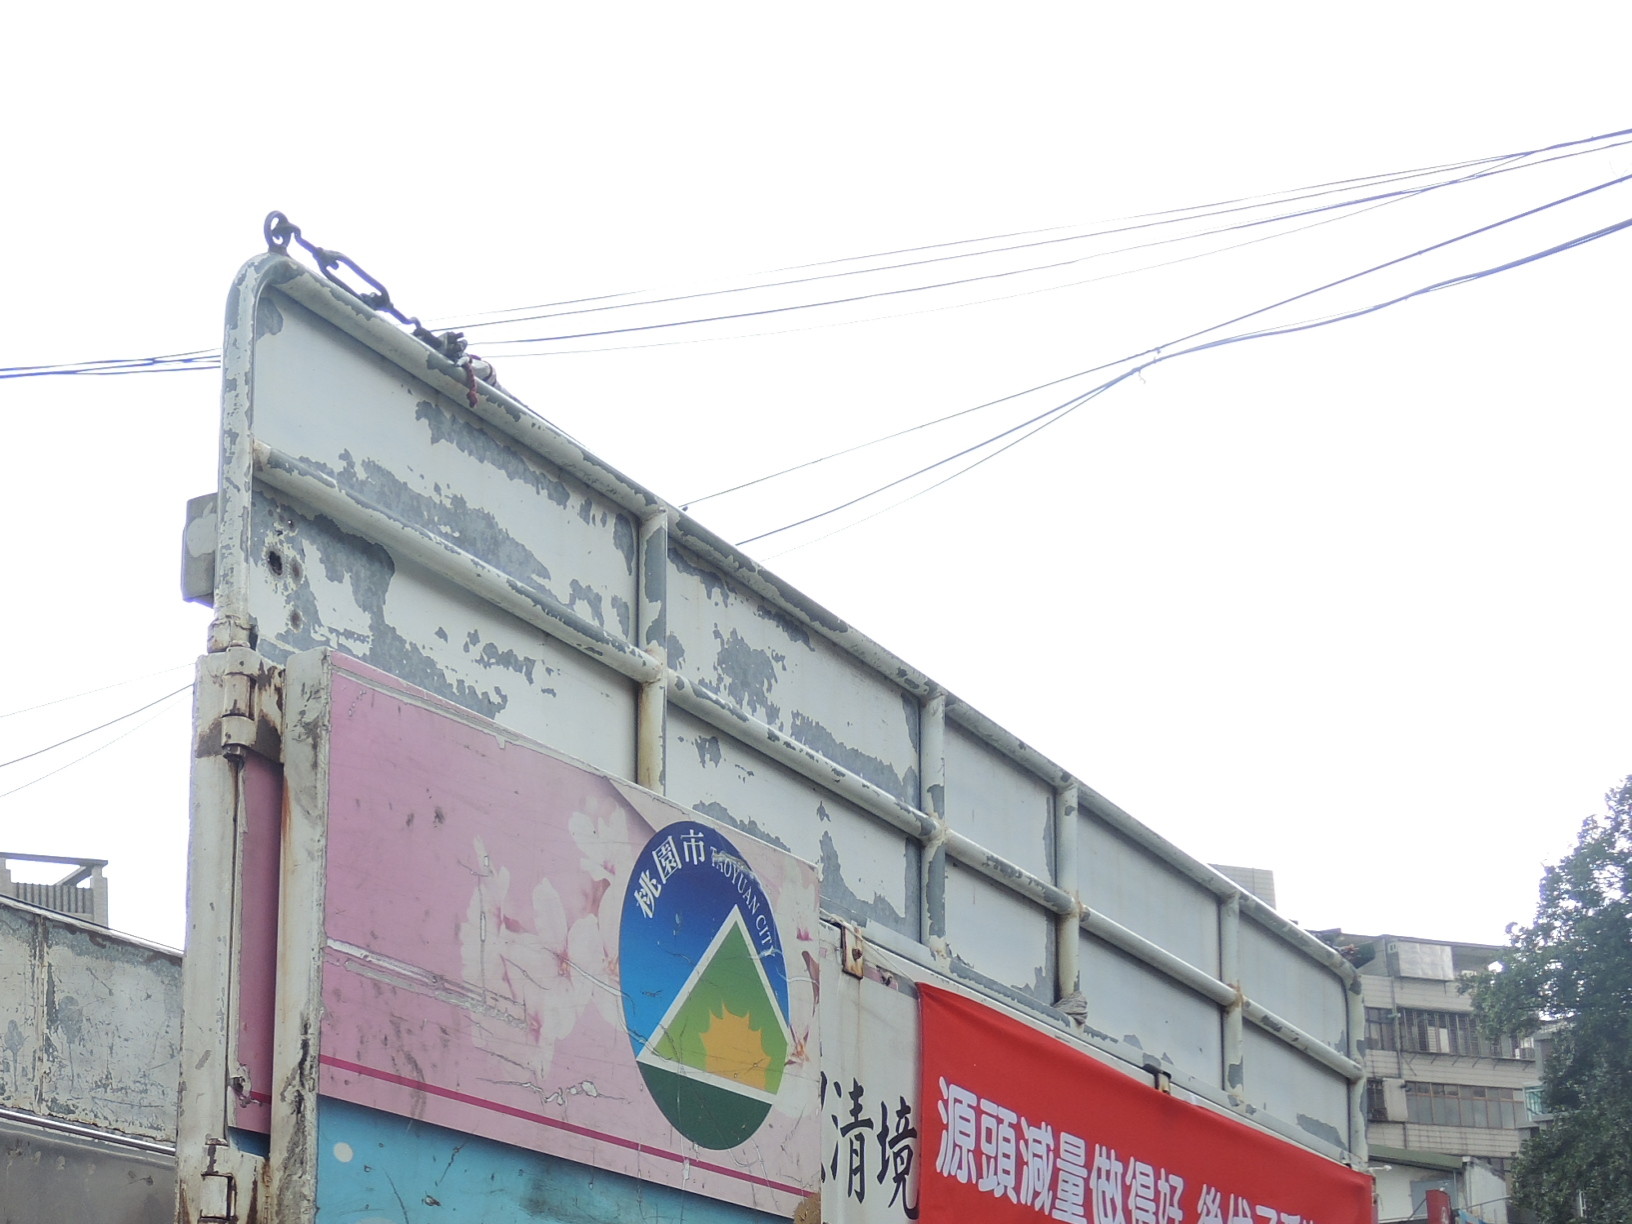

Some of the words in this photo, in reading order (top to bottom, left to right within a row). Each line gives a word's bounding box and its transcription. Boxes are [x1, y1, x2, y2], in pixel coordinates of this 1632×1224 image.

[633, 829, 706, 919] 桃園市
[755, 914, 776, 957] CITY
